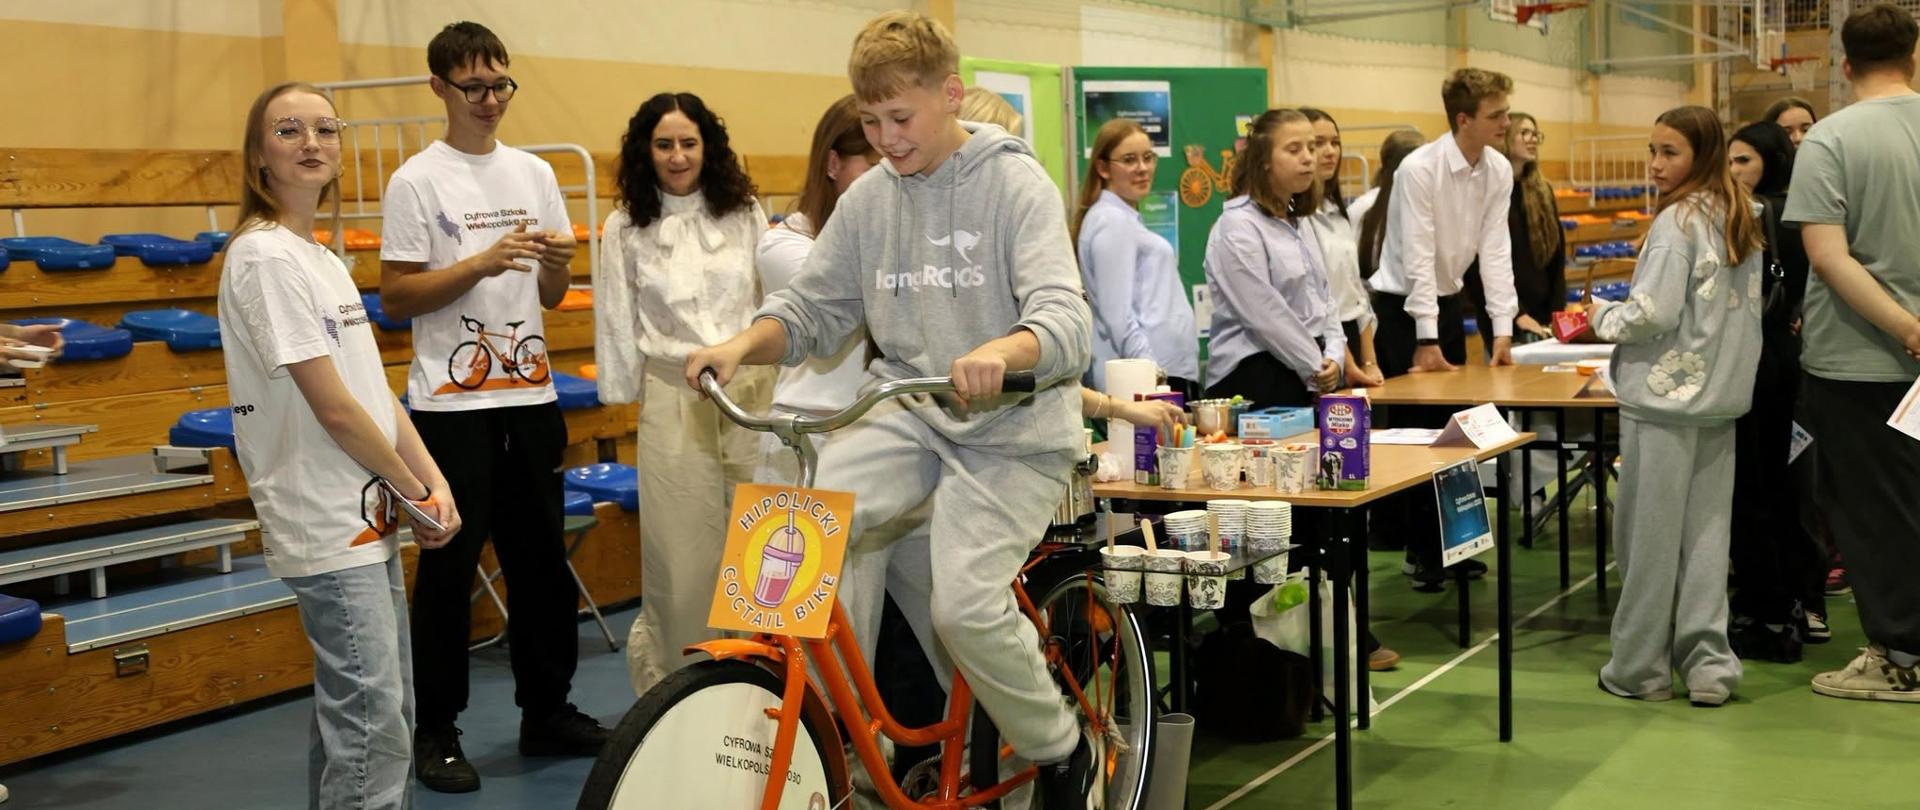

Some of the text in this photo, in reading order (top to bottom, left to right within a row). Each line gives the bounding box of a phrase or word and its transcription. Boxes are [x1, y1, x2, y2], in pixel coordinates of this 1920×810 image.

[740, 491, 840, 537] HIPOLICKI
[723, 566, 837, 628] COCTAIL BIKE
[723, 735, 761, 755] CYFROWA
[715, 752, 770, 776] WIELKOPOLS
